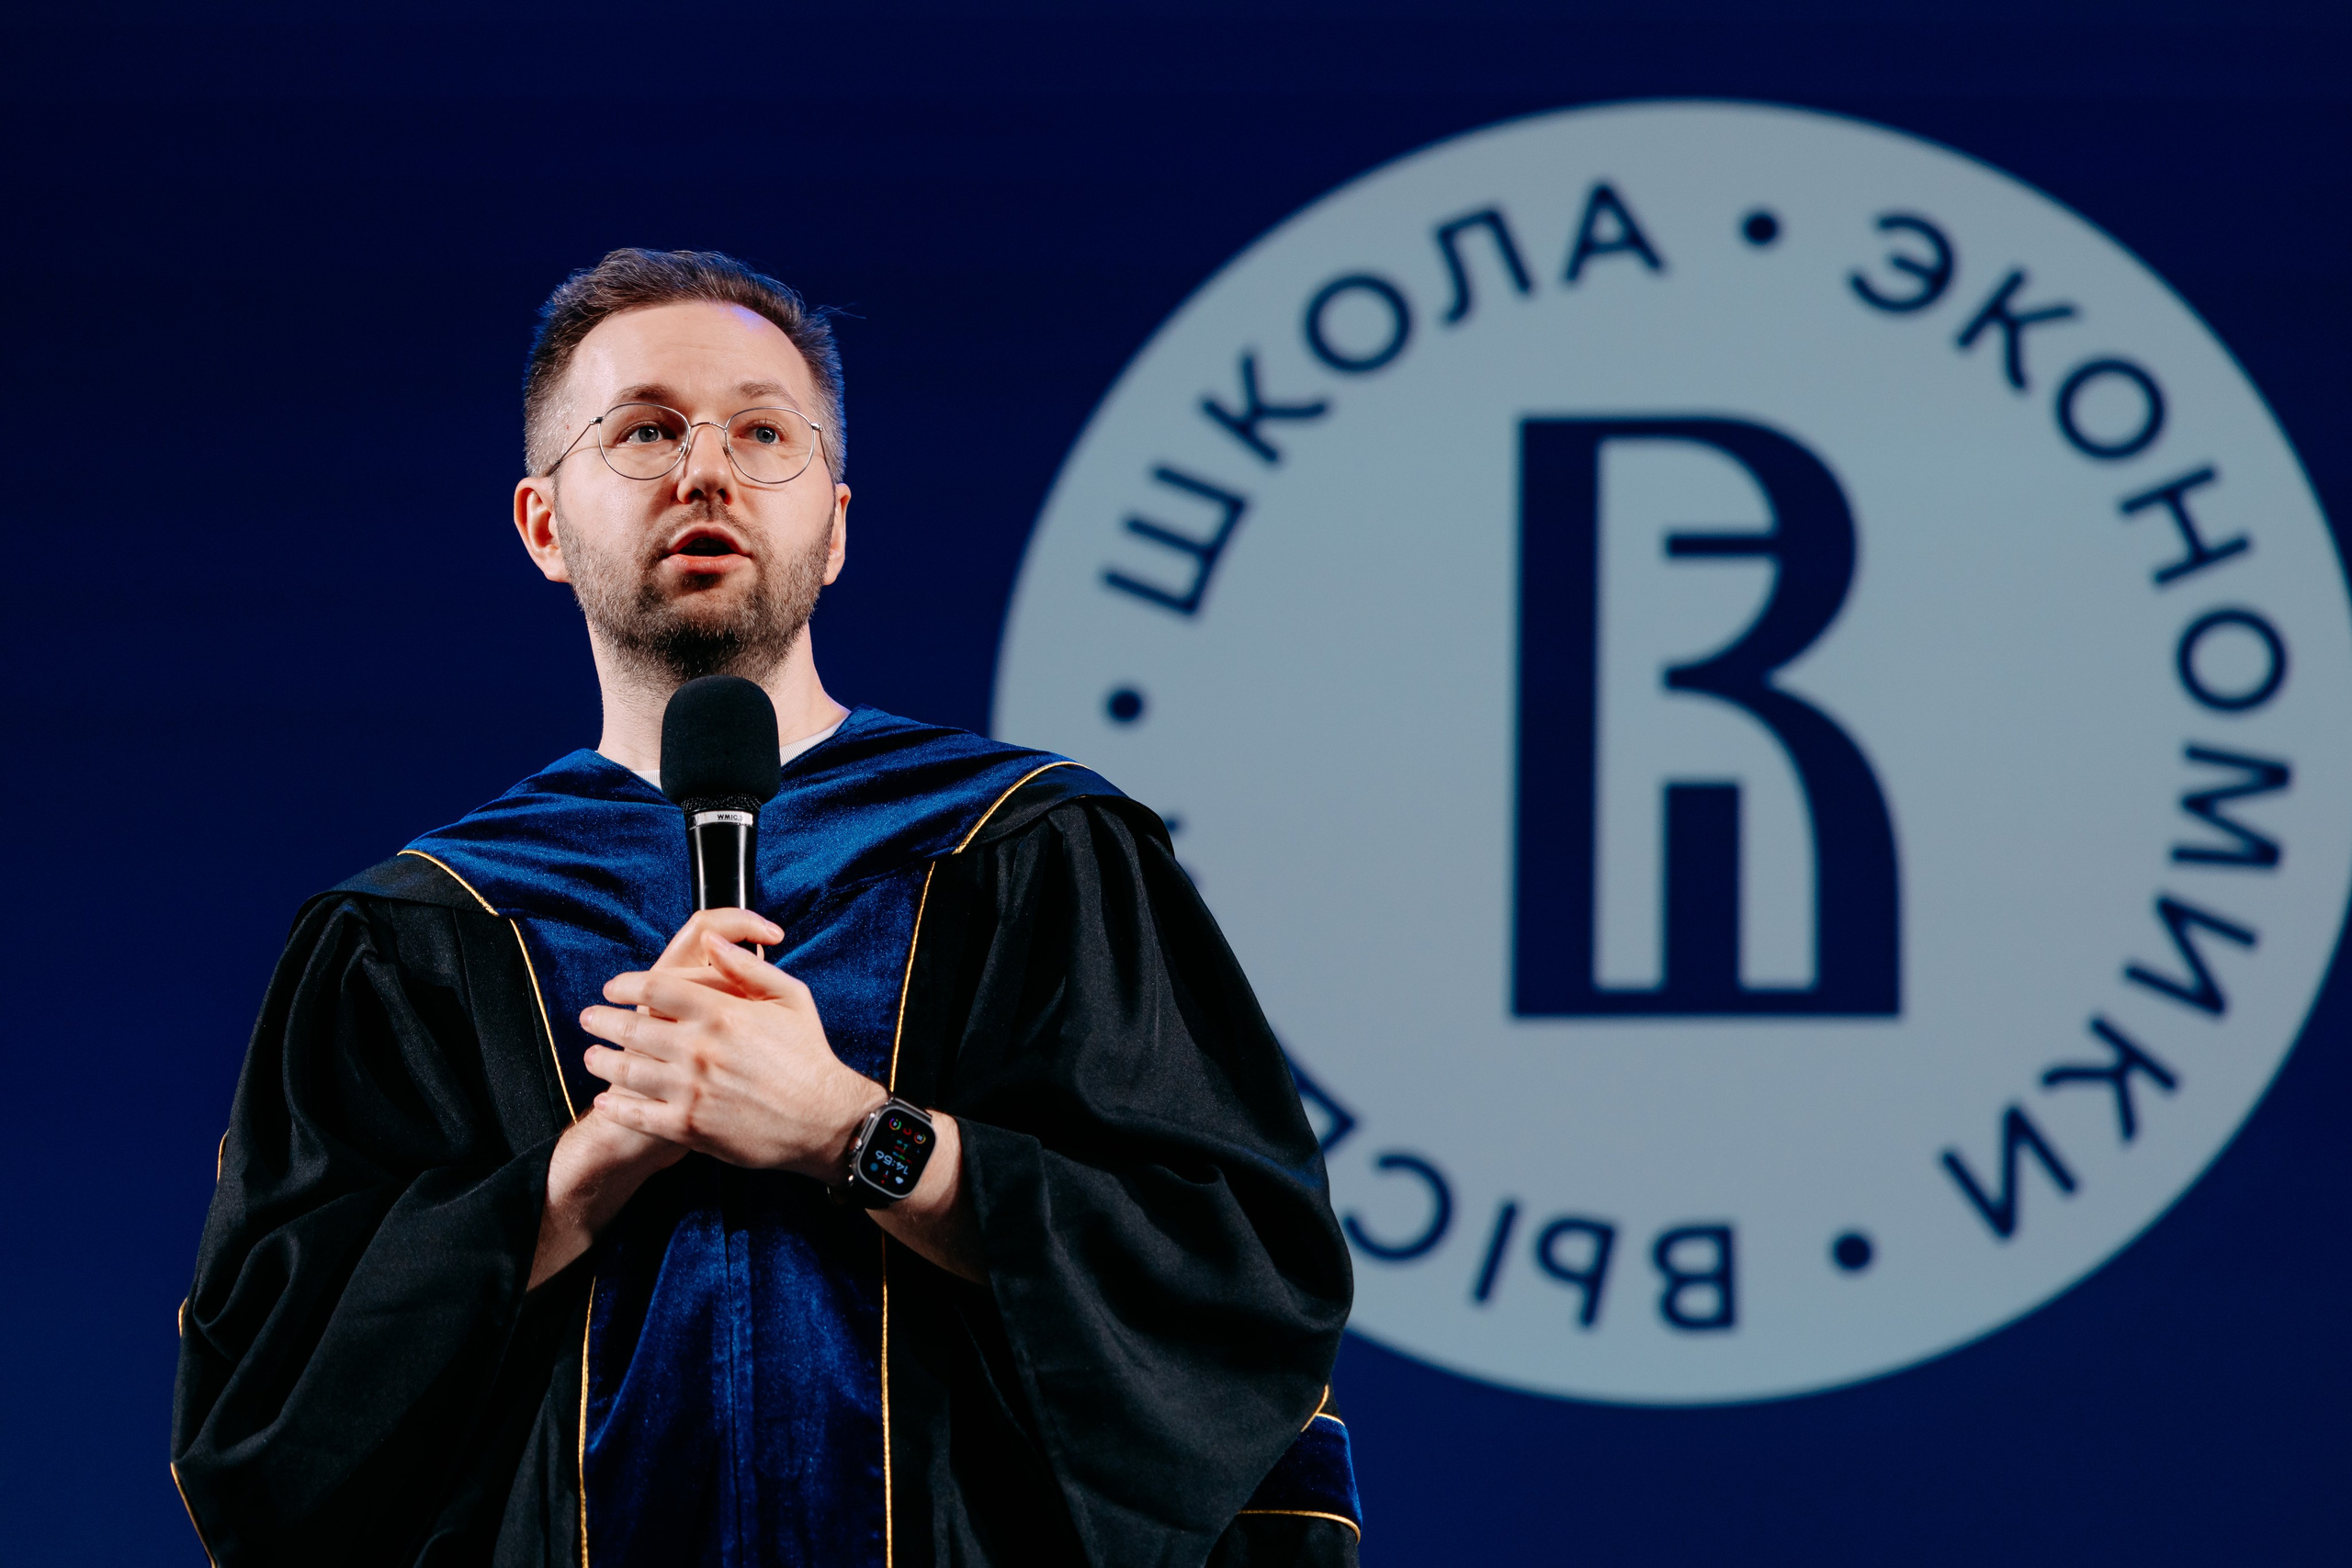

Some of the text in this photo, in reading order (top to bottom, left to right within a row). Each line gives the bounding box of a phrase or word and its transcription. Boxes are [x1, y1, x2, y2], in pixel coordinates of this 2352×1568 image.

[1100, 179, 1668, 621] ШКОЛА
[1846, 210, 2295, 1244] ЭКОНОМИКИ
[876, 1150, 909, 1175] 14:56
